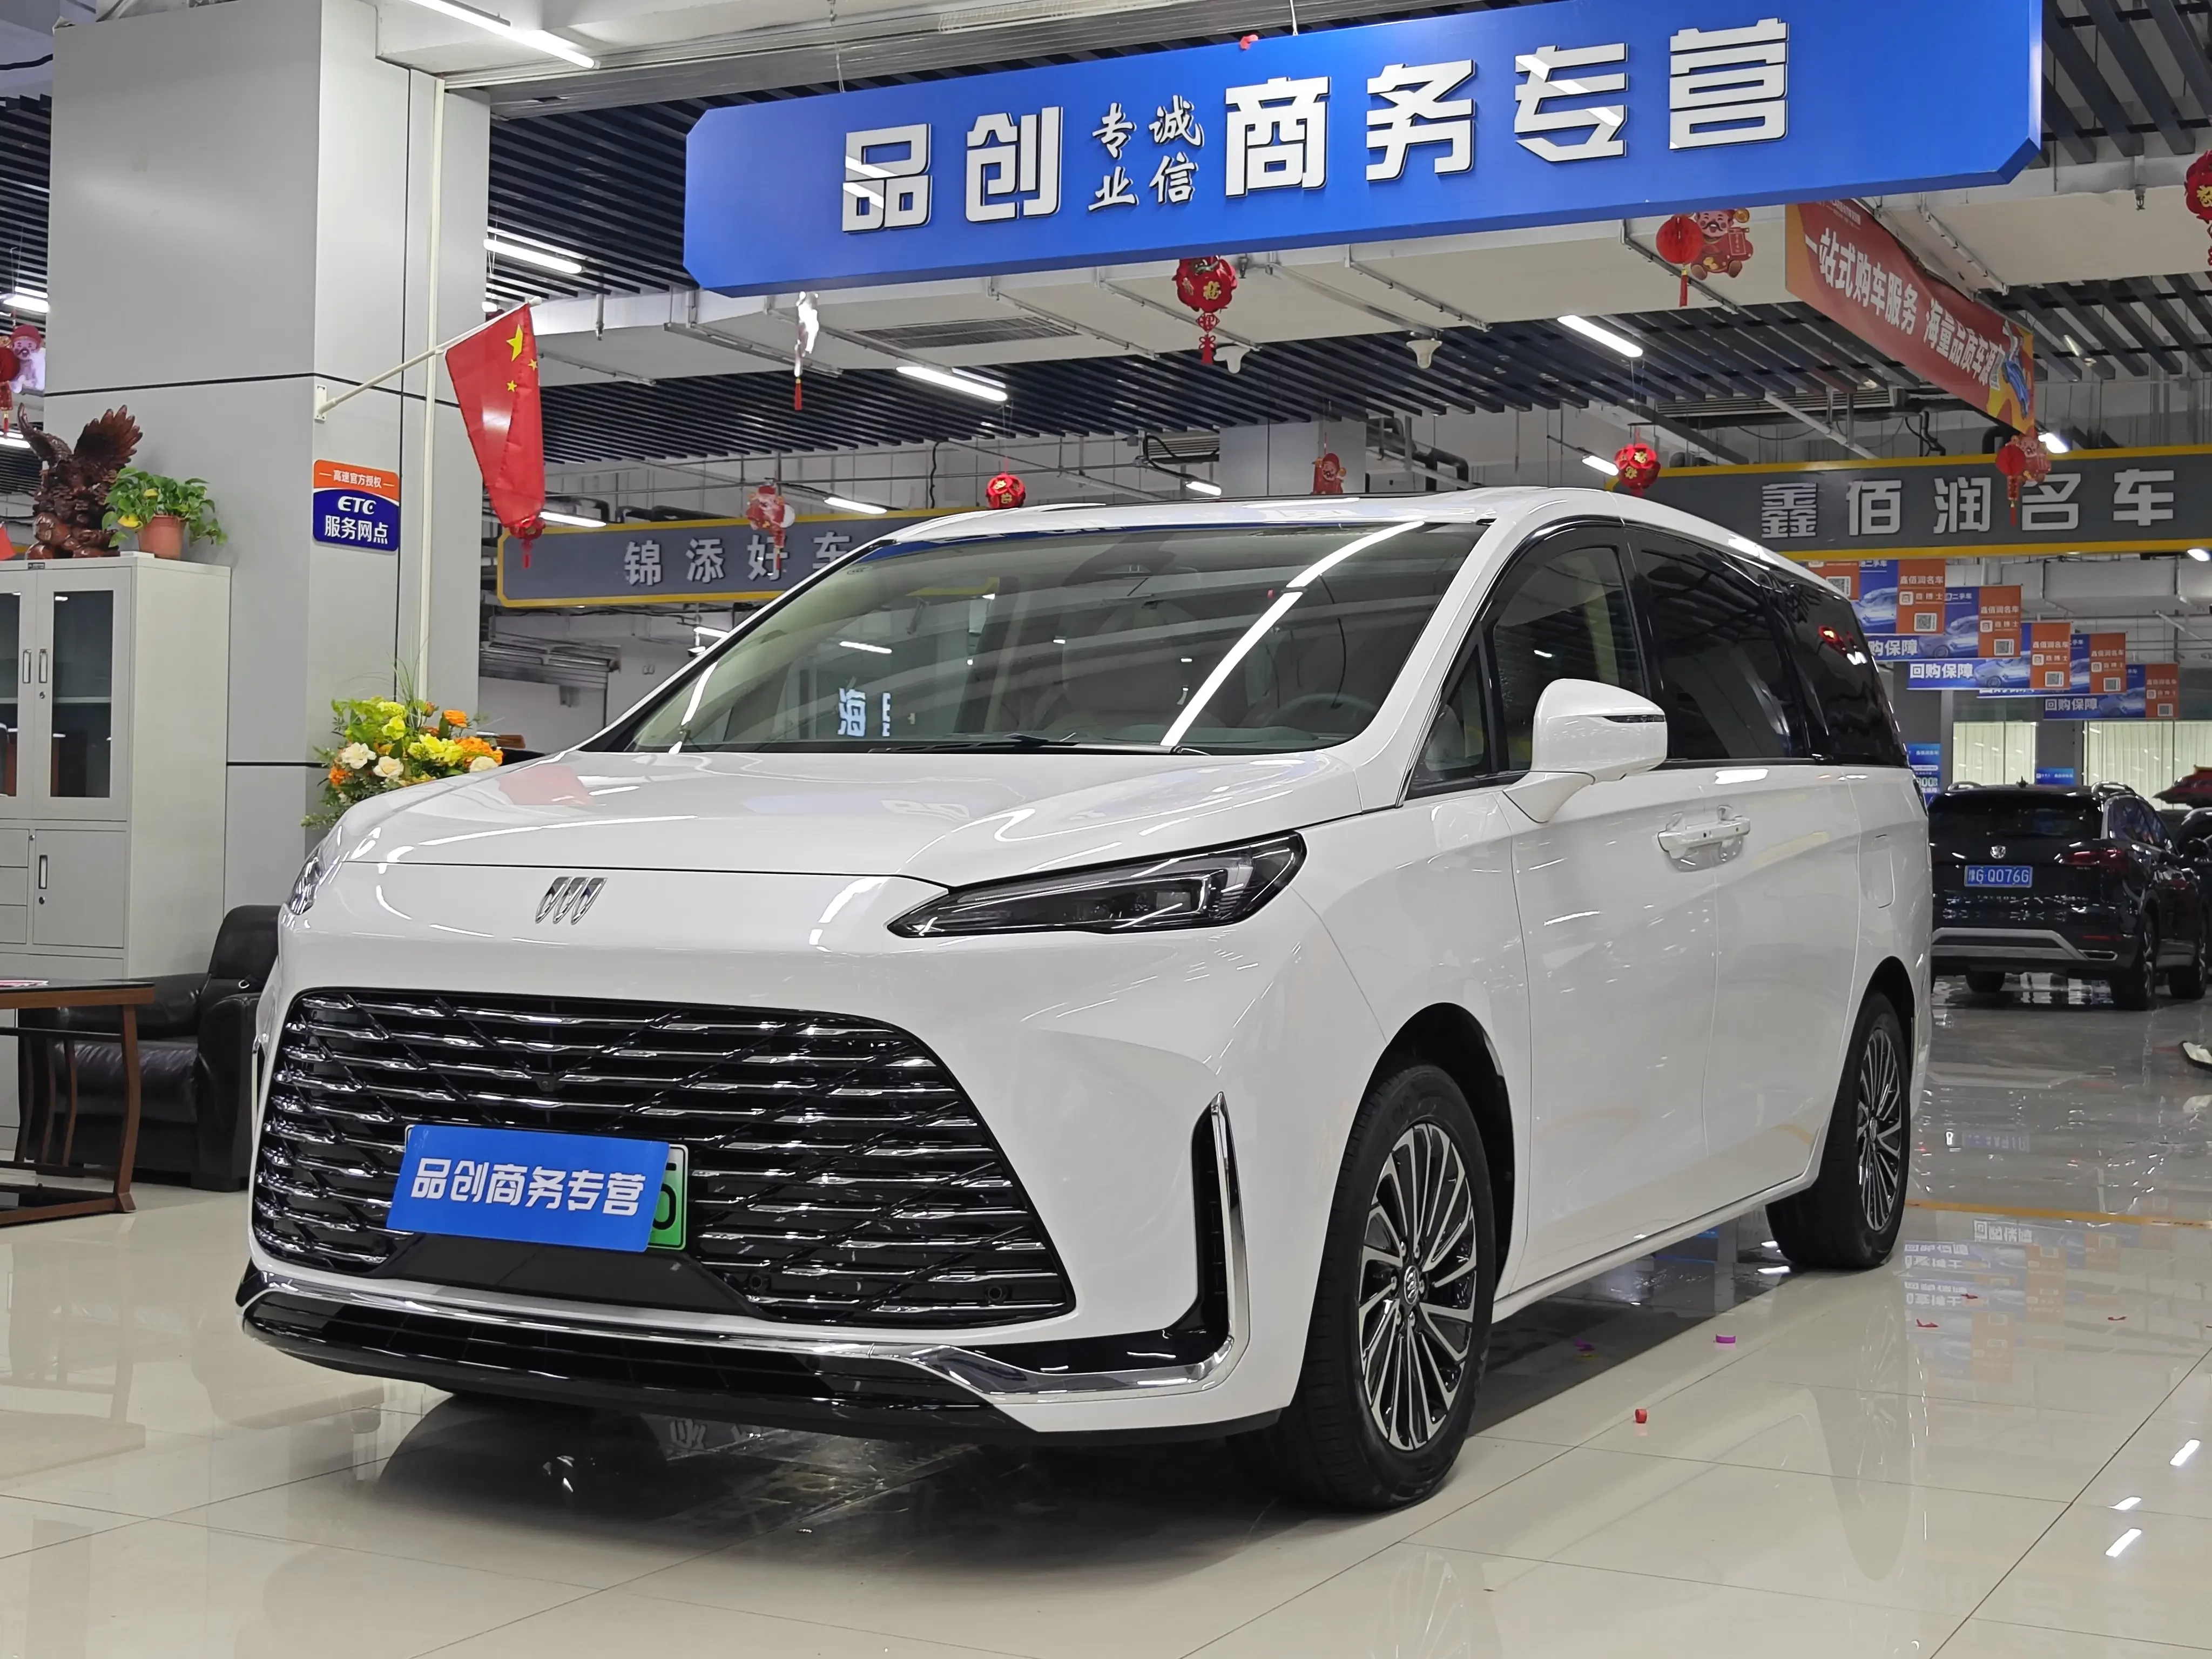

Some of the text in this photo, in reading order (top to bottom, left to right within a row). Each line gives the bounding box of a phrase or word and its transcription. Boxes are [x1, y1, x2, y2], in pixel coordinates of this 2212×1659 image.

[842, 17, 1789, 233] 品创 商务专营
[1804, 227, 2002, 386] 一站式购车服务 海量品质车源
[333, 469, 382, 488] 高速官方授权
[338, 495, 377, 515] ETC
[1761, 468, 2175, 538] 鑫佰润名车
[325, 515, 389, 544] 服务网点
[624, 531, 851, 585] 锦添好车
[1910, 663, 1974, 679] 回购保障
[2045, 698, 2099, 711] 回购保障
[410, 1157, 646, 1216] 品创商务专营
